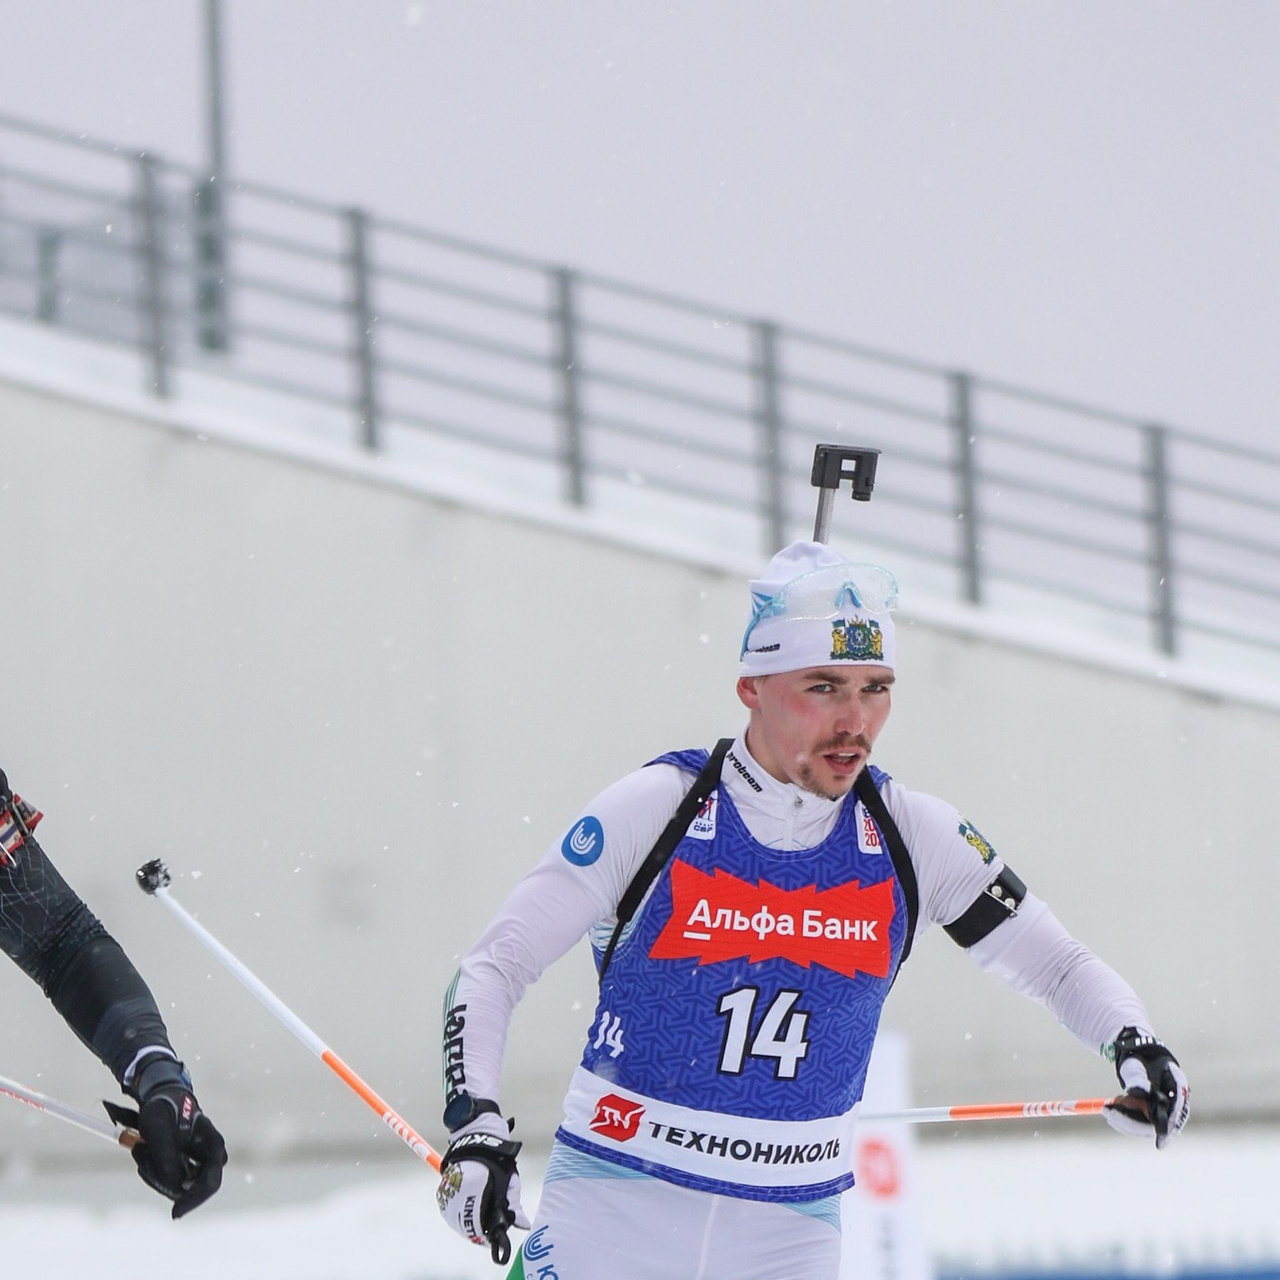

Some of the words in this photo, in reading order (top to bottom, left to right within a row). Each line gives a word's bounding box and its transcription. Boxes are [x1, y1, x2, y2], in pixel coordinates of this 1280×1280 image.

[683, 899, 794, 941] Альфа
[802, 909, 878, 942] Банк
[593, 1010, 624, 1059] 14
[717, 986, 809, 1081] 14
[648, 1120, 840, 1165] ТЕХНОНИКОЛЬ
